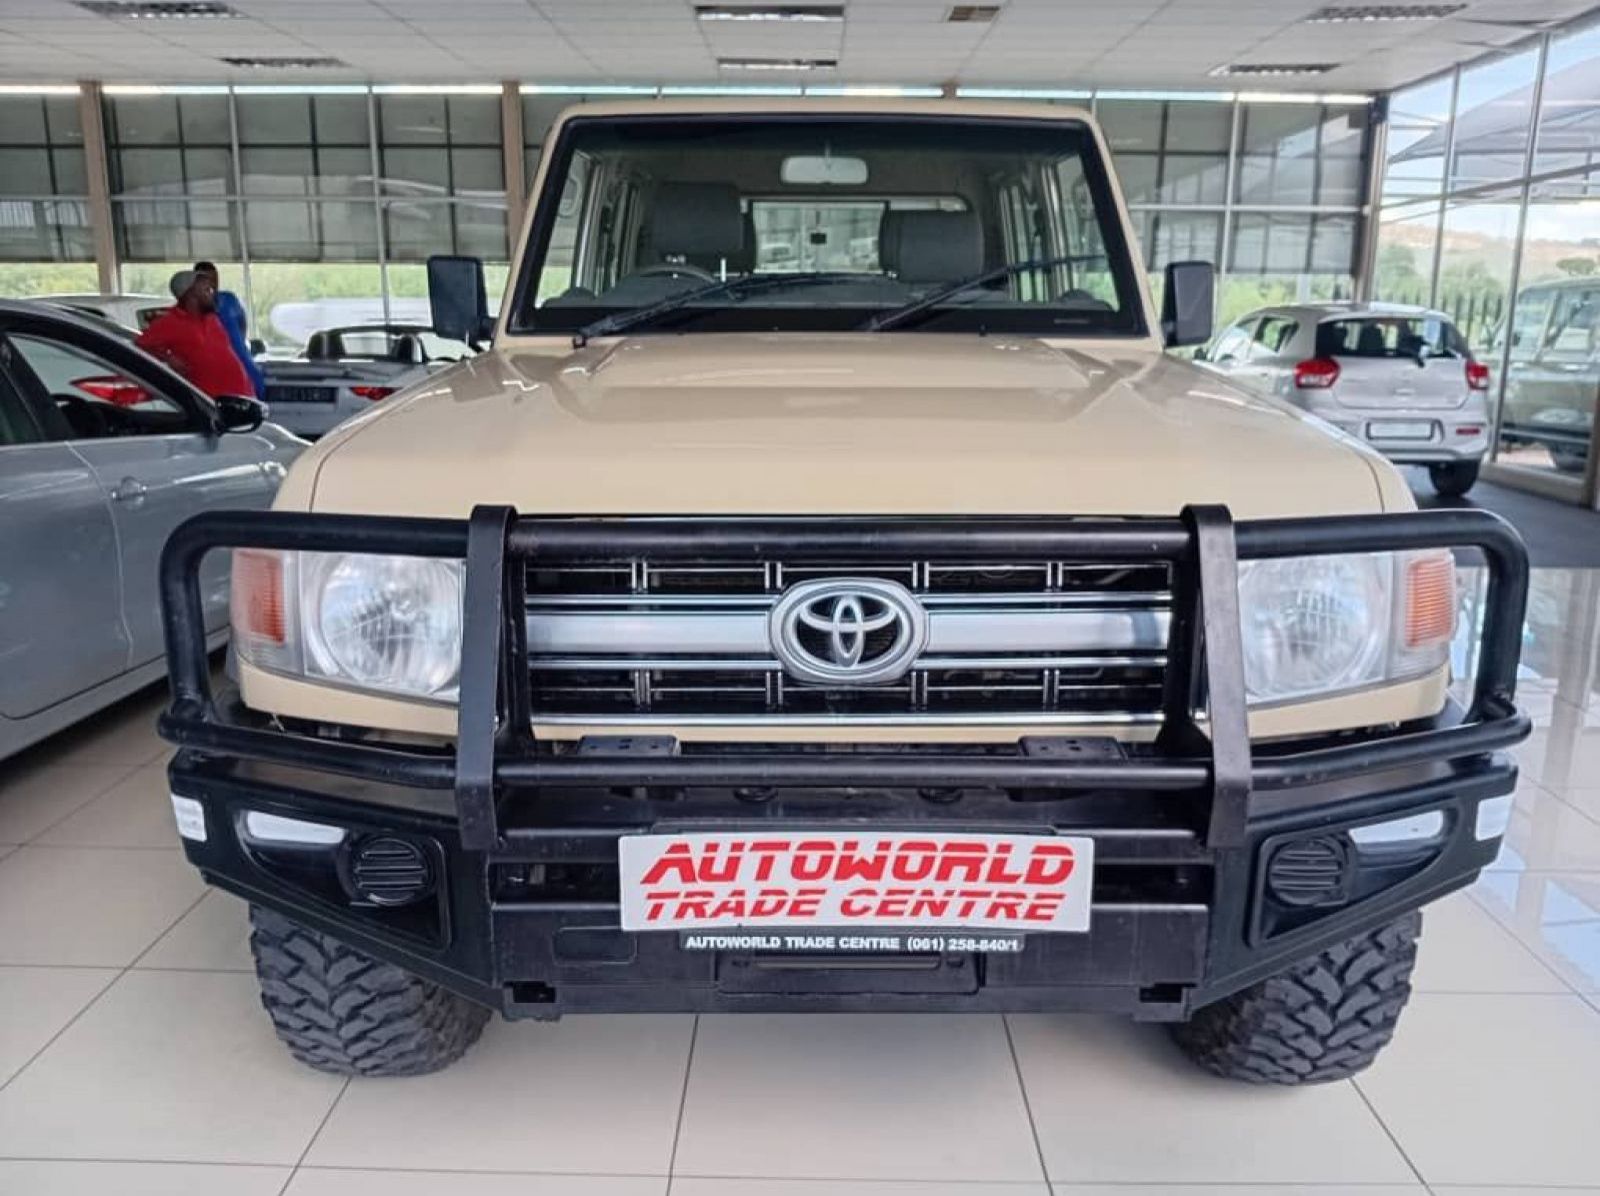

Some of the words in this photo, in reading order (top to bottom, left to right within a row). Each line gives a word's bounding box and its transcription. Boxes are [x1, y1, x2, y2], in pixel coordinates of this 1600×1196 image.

[640, 840, 1075, 885] AUTOWORLD
[645, 888, 828, 921] TRADE
[840, 888, 1066, 921] CENTRE
[686, 936, 781, 949] AUTOWORLD
[785, 936, 836, 949] TRADE
[839, 936, 900, 950] CENTRE
